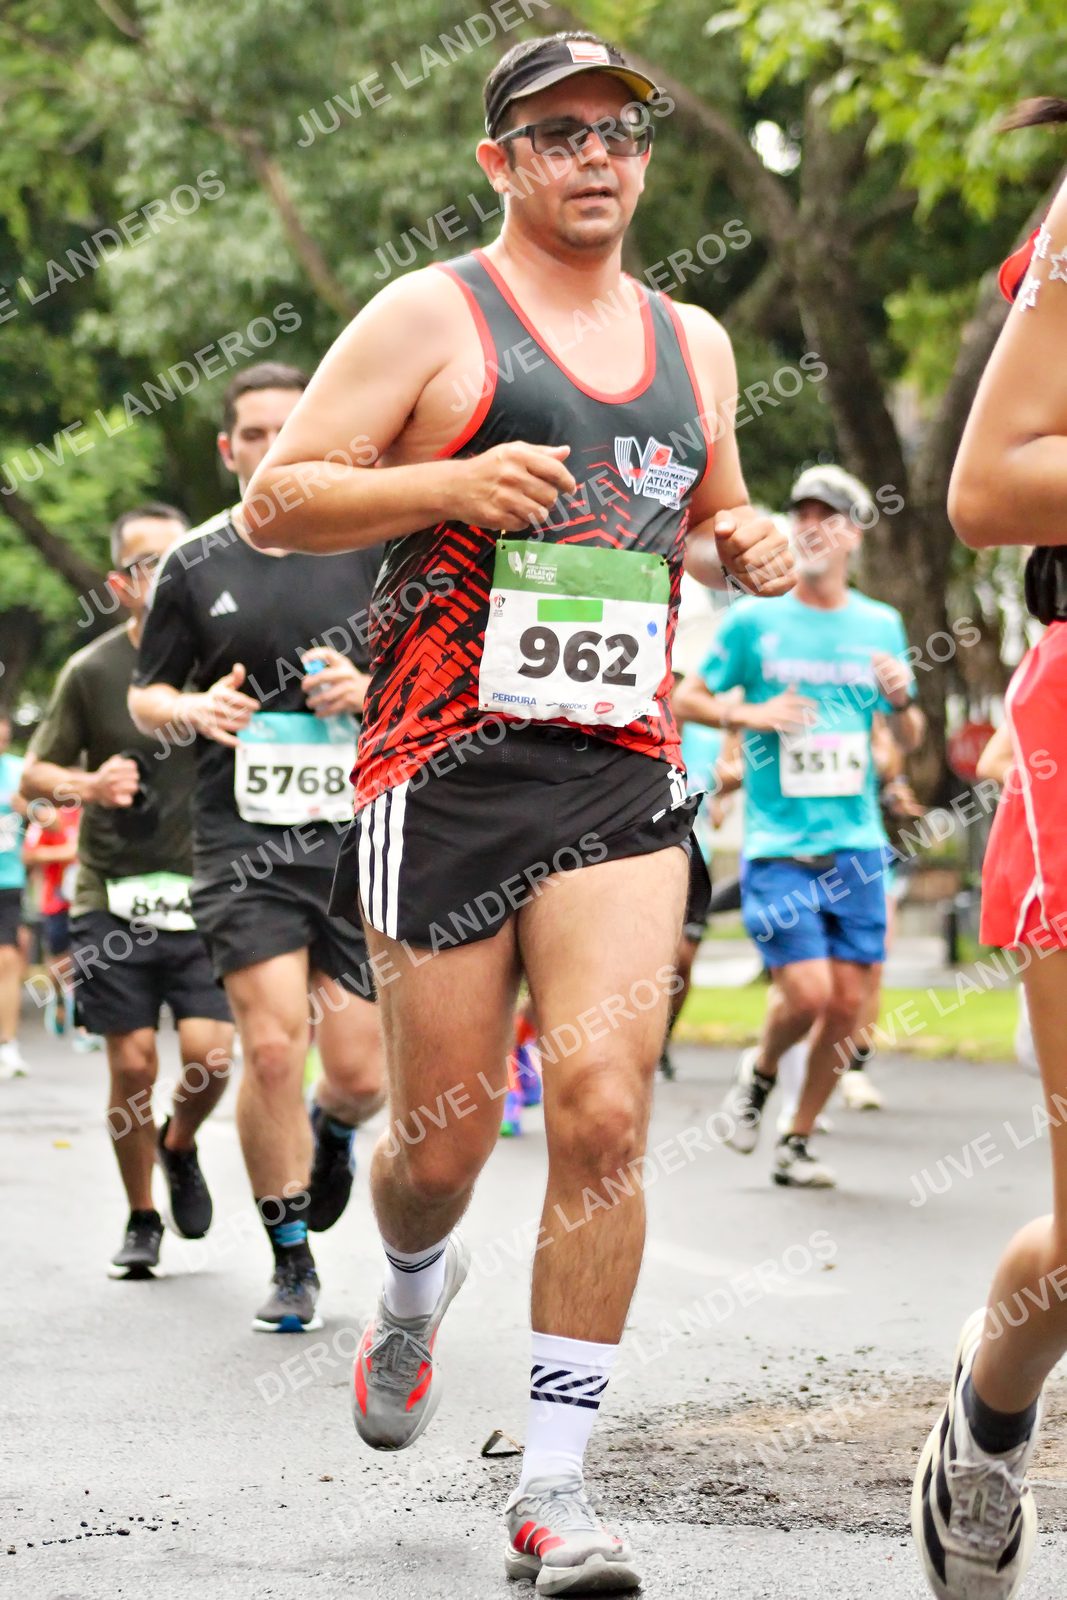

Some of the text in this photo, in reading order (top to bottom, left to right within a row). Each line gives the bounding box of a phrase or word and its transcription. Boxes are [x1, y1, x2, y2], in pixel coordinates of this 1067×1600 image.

[518, 626, 639, 686] 962
[492, 693, 537, 705] PERDURA
[246, 765, 345, 795] 5768
